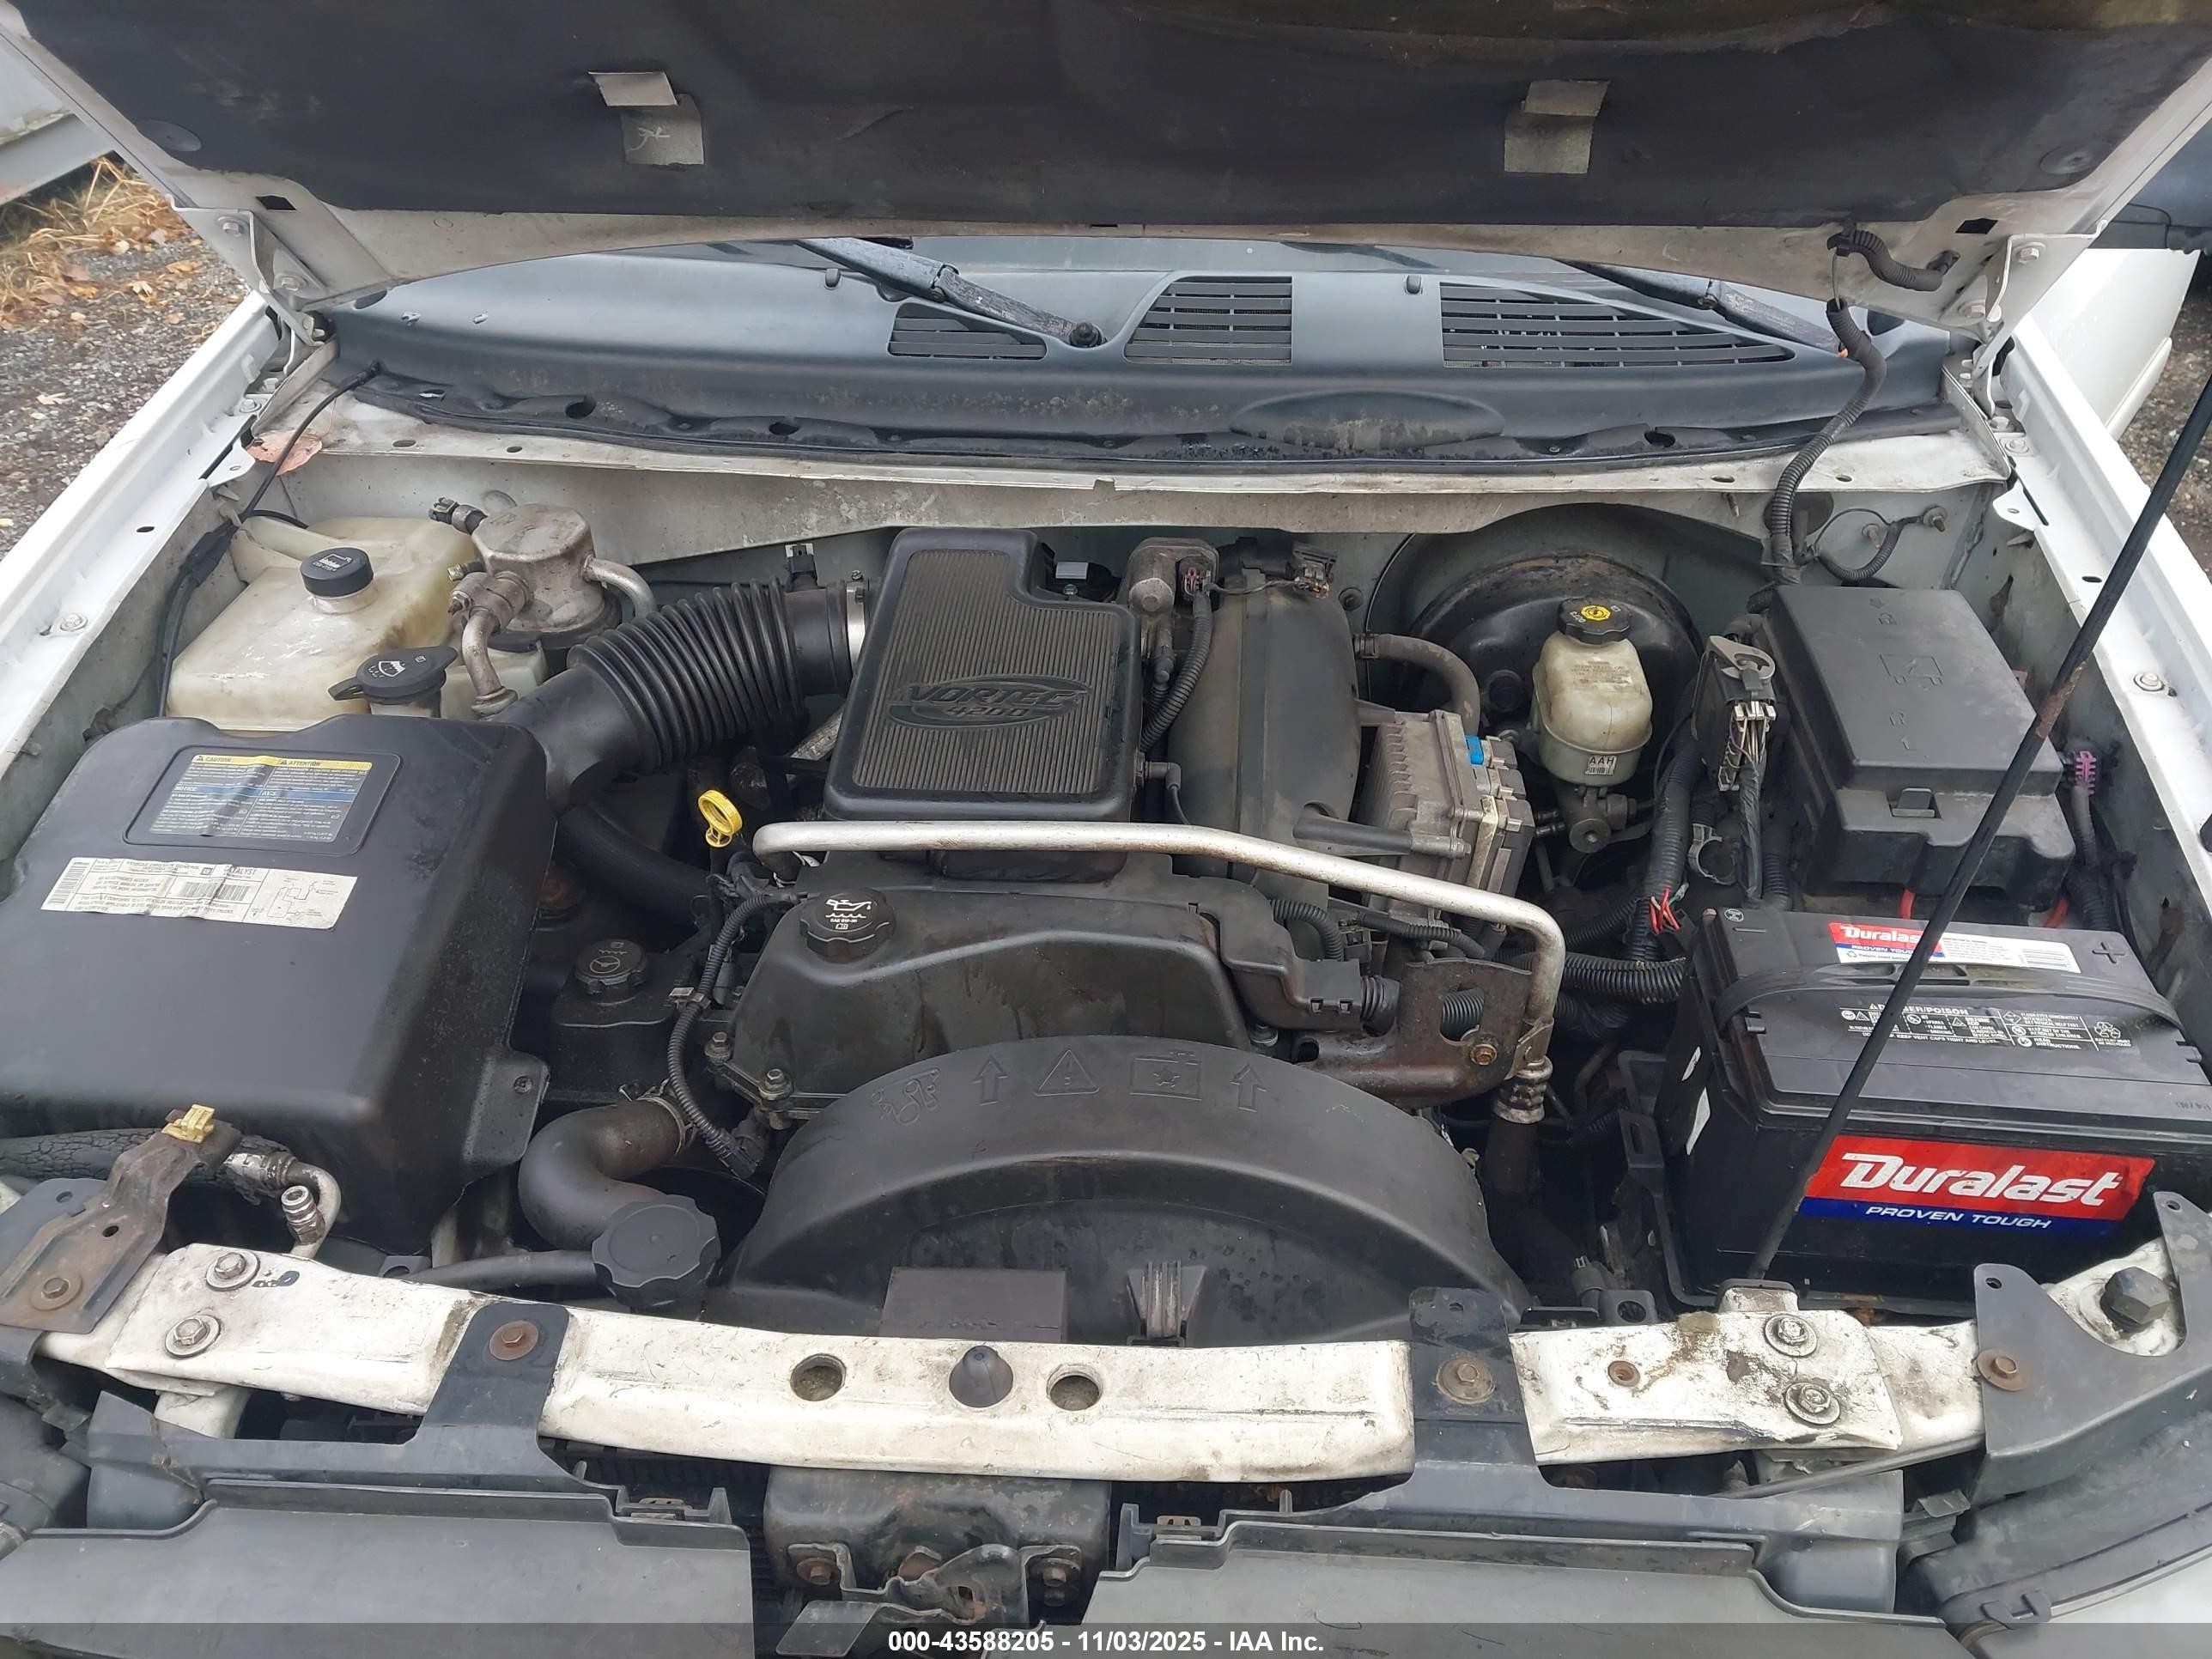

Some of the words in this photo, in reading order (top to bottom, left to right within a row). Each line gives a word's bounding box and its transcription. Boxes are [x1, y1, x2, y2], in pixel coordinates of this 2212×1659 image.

[945, 706, 1030, 718] 4200
[223, 865, 257, 876] CATALYST
[1840, 925, 1922, 944] Duralas
[1840, 1152, 2123, 1206] Duralast
[1865, 1206, 1963, 1223] PROVEN
[1972, 1213, 2053, 1229] TOUGH
